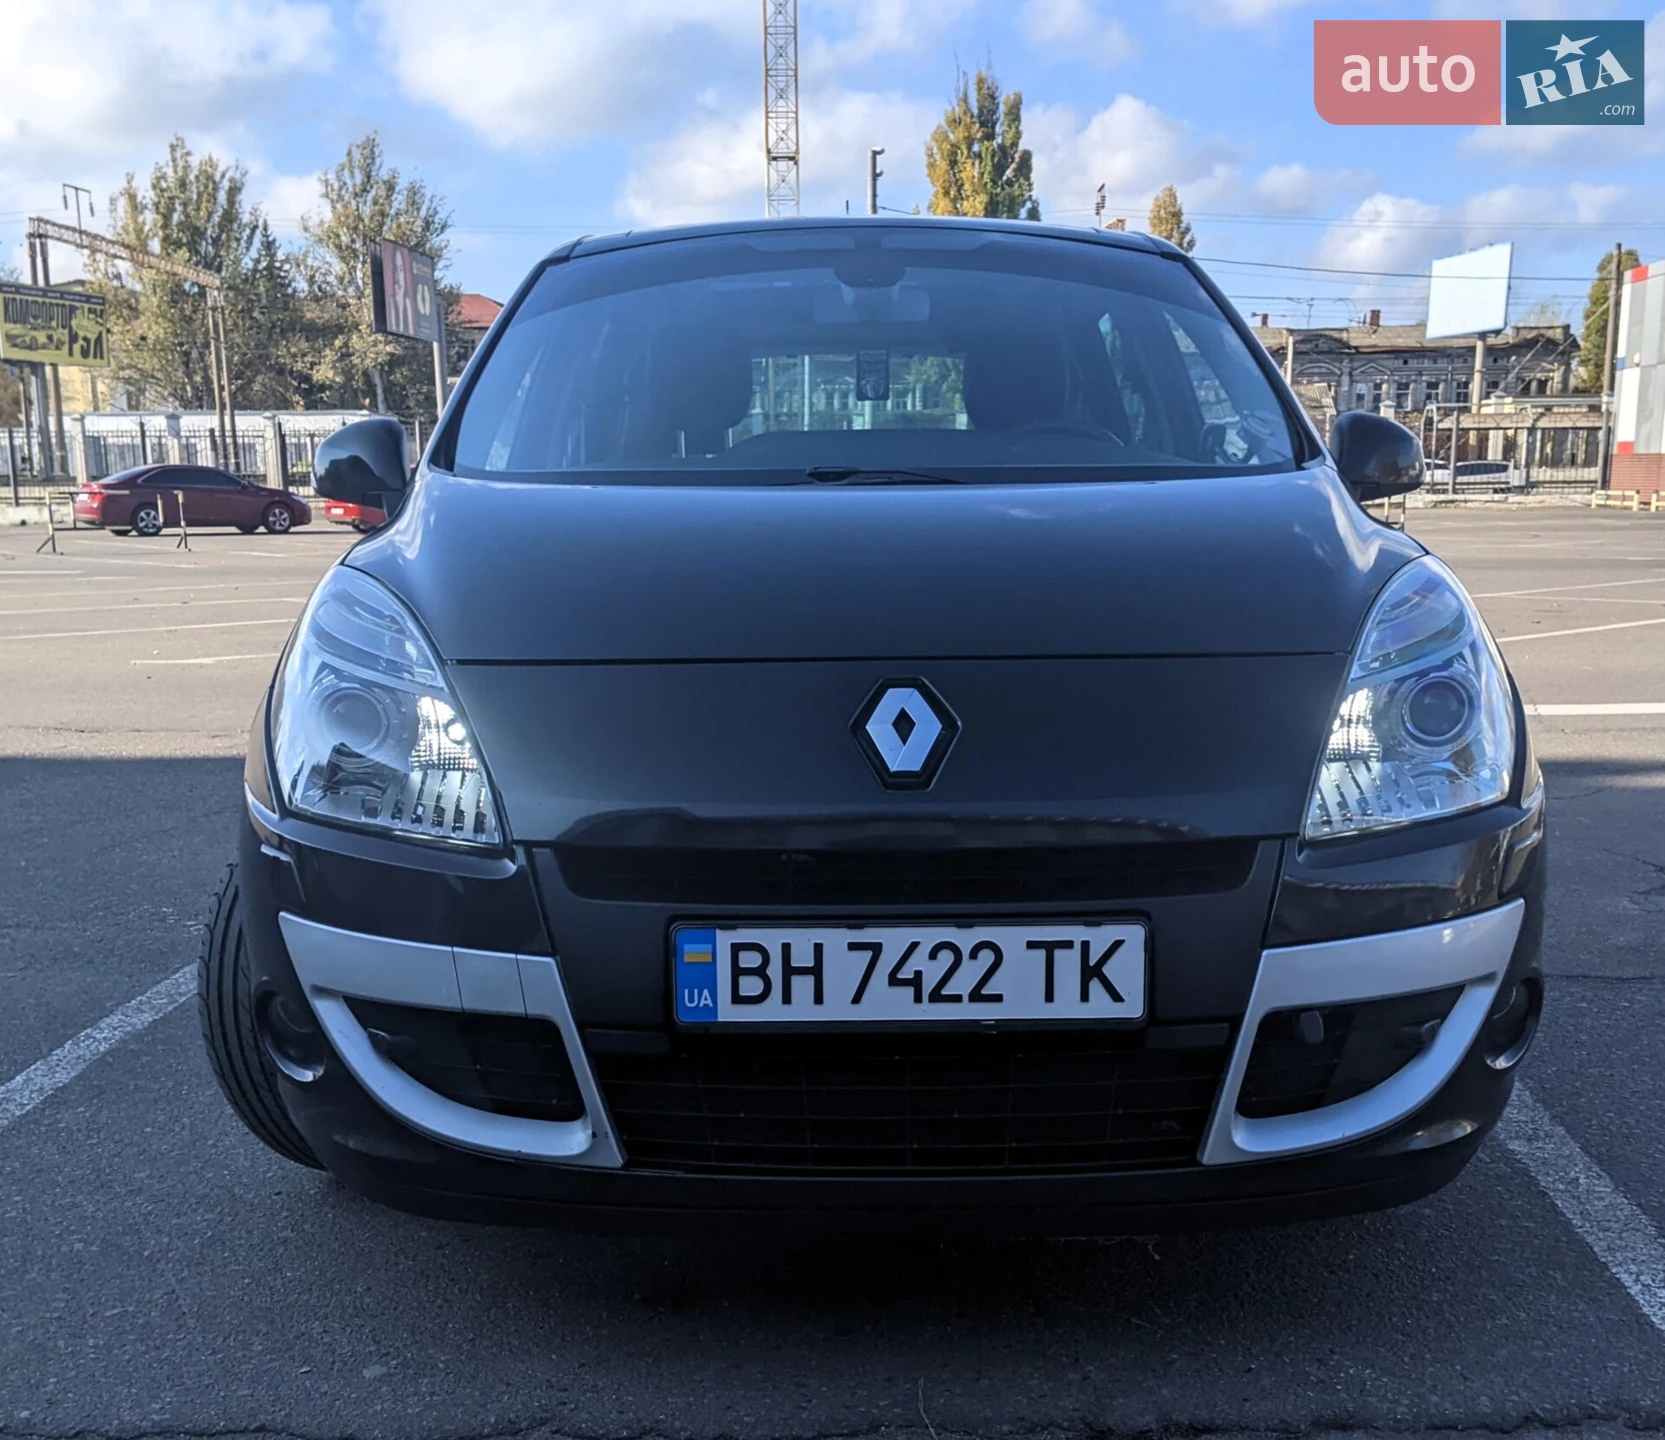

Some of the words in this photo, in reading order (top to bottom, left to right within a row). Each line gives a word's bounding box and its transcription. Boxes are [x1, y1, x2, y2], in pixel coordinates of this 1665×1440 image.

[730, 941, 824, 1005] BH
[847, 940, 1004, 1004] 7422
[1025, 938, 1126, 1003] TK
[684, 988, 713, 1008] UA
